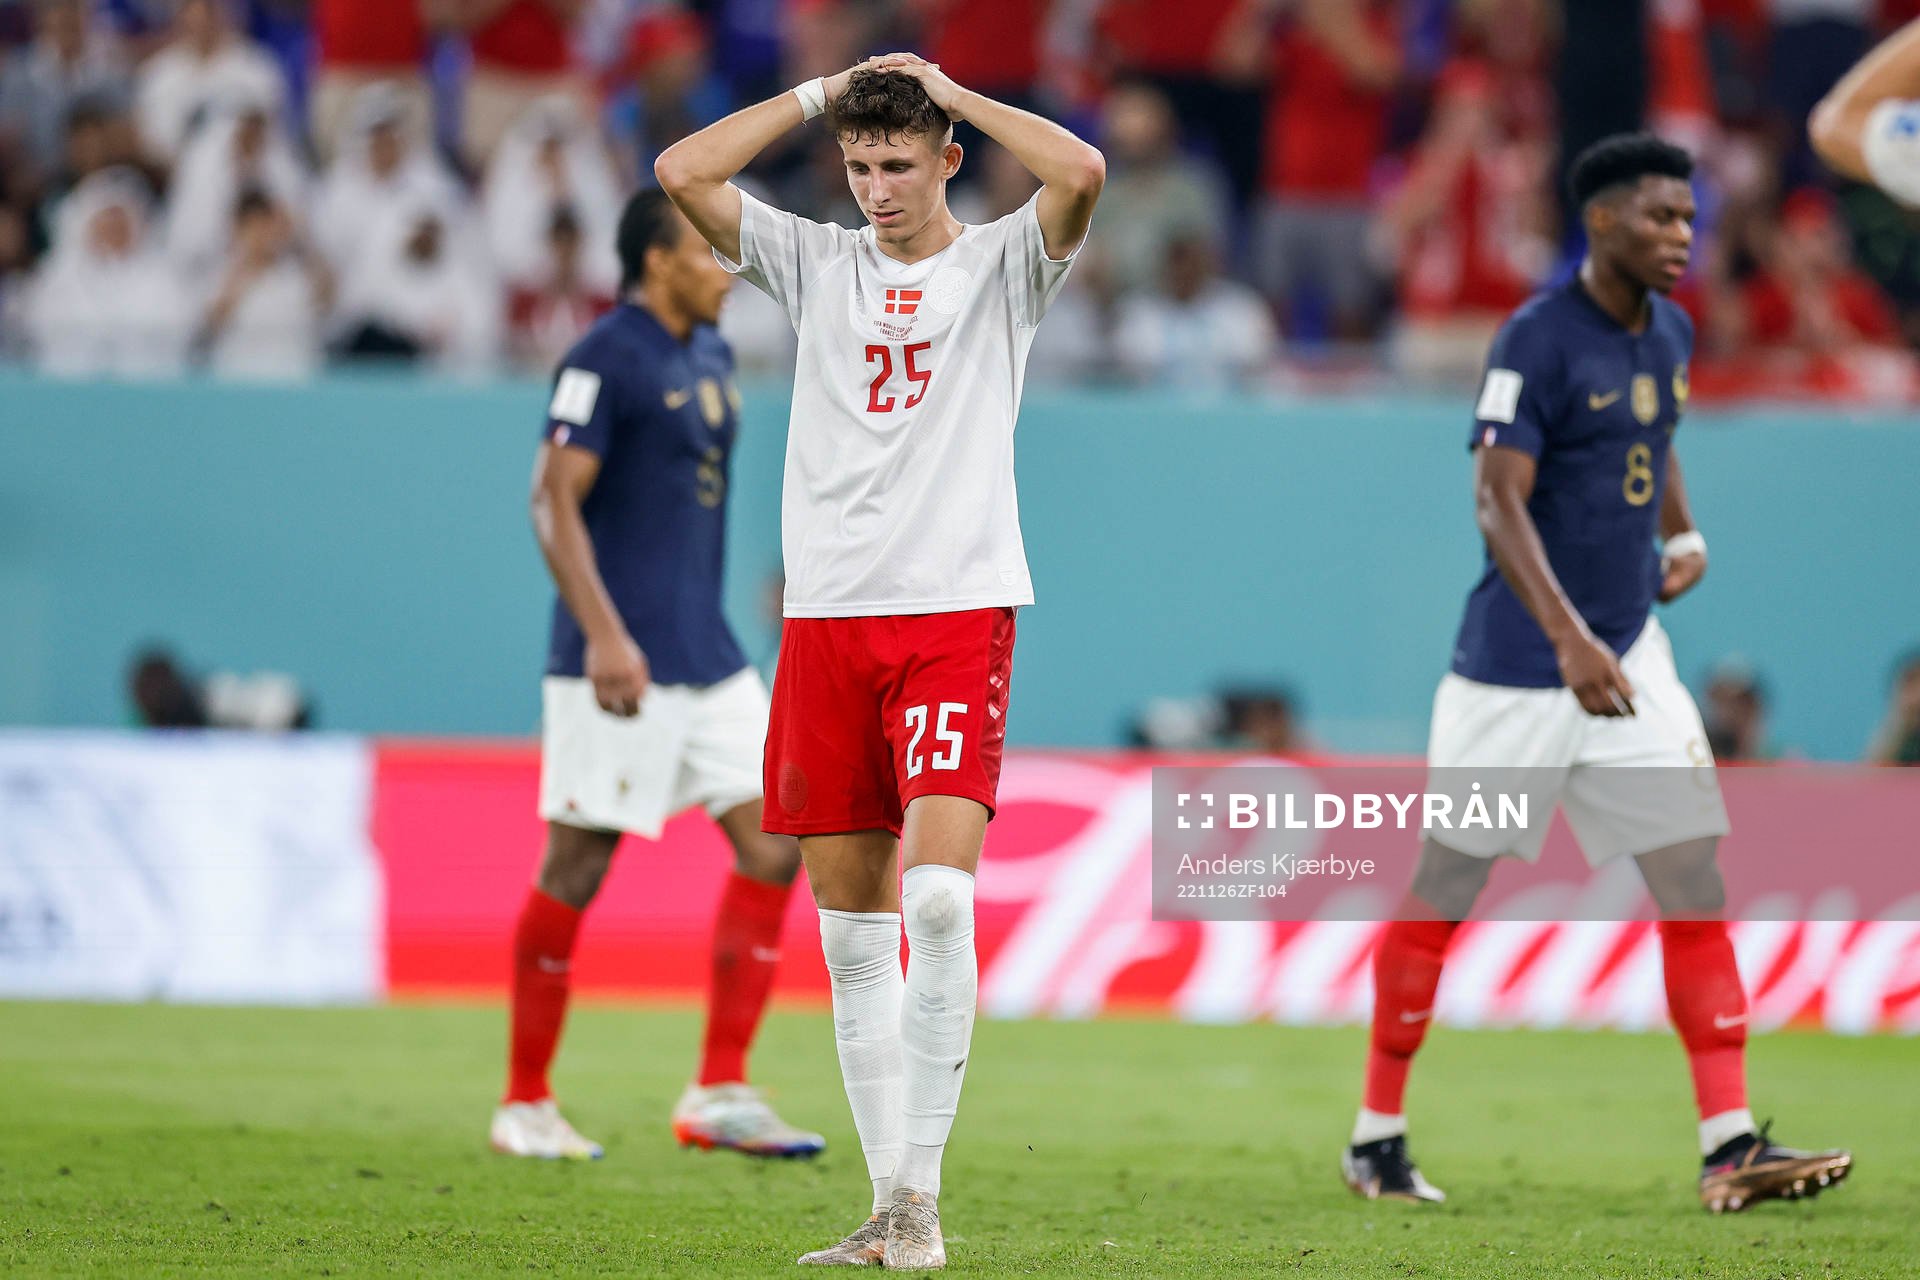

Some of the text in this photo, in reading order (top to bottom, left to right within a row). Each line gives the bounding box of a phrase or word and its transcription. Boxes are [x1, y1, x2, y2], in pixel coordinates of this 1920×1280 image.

[865, 341, 932, 413] 25
[1622, 443, 1654, 507] 8
[904, 701, 968, 781] 25
